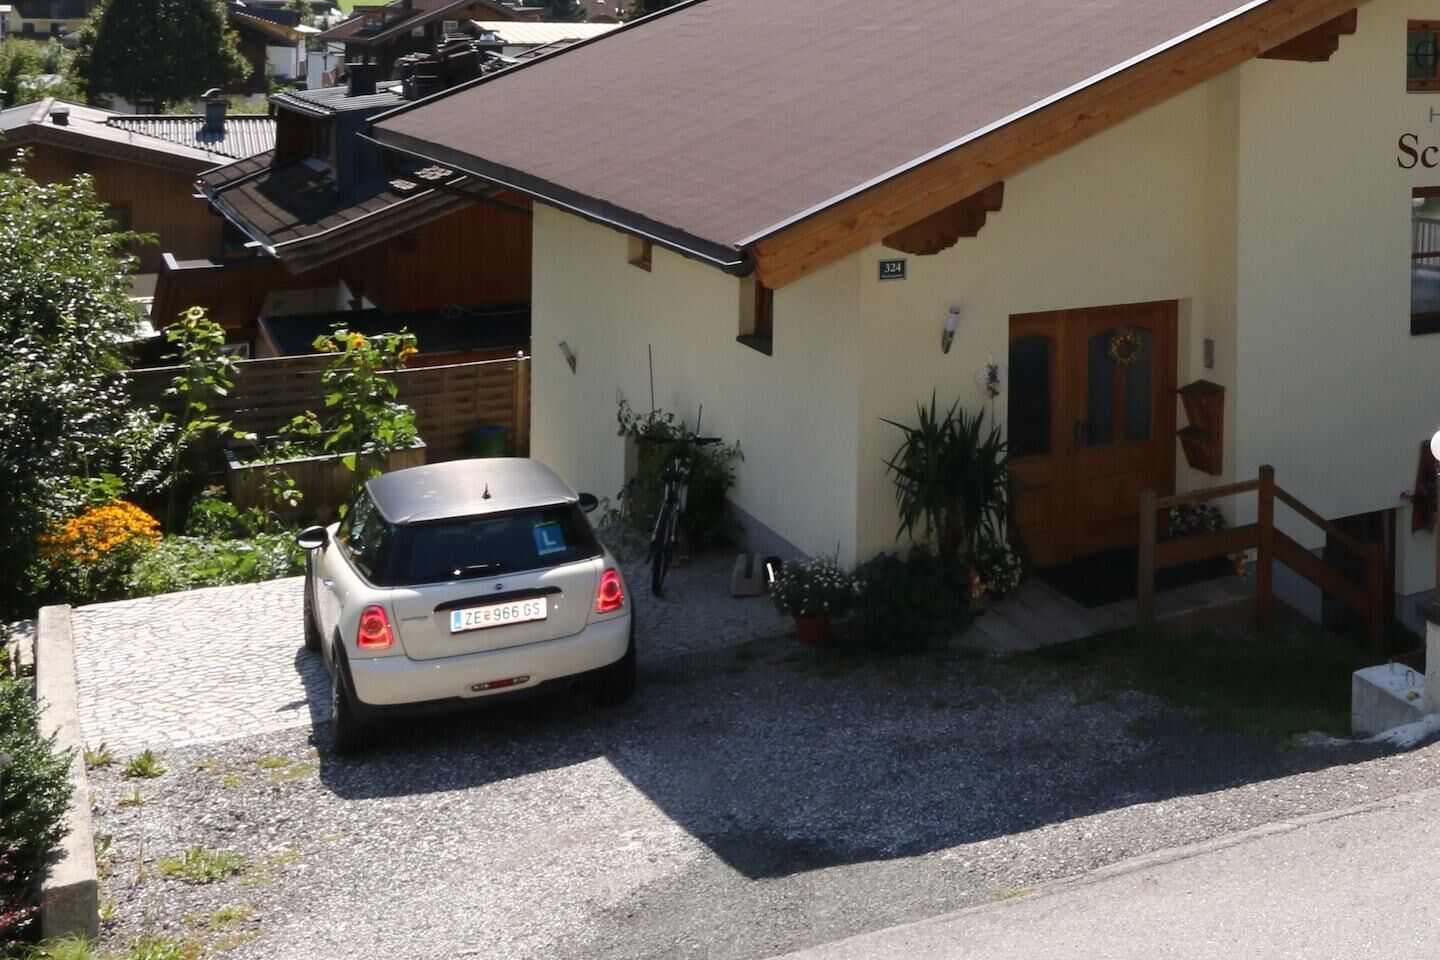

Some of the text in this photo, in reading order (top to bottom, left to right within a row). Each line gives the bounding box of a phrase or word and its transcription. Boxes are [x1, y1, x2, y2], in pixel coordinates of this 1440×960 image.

[884, 262, 901, 273] 324
[542, 530, 557, 546] L
[465, 602, 541, 626] ZE 966 GS
